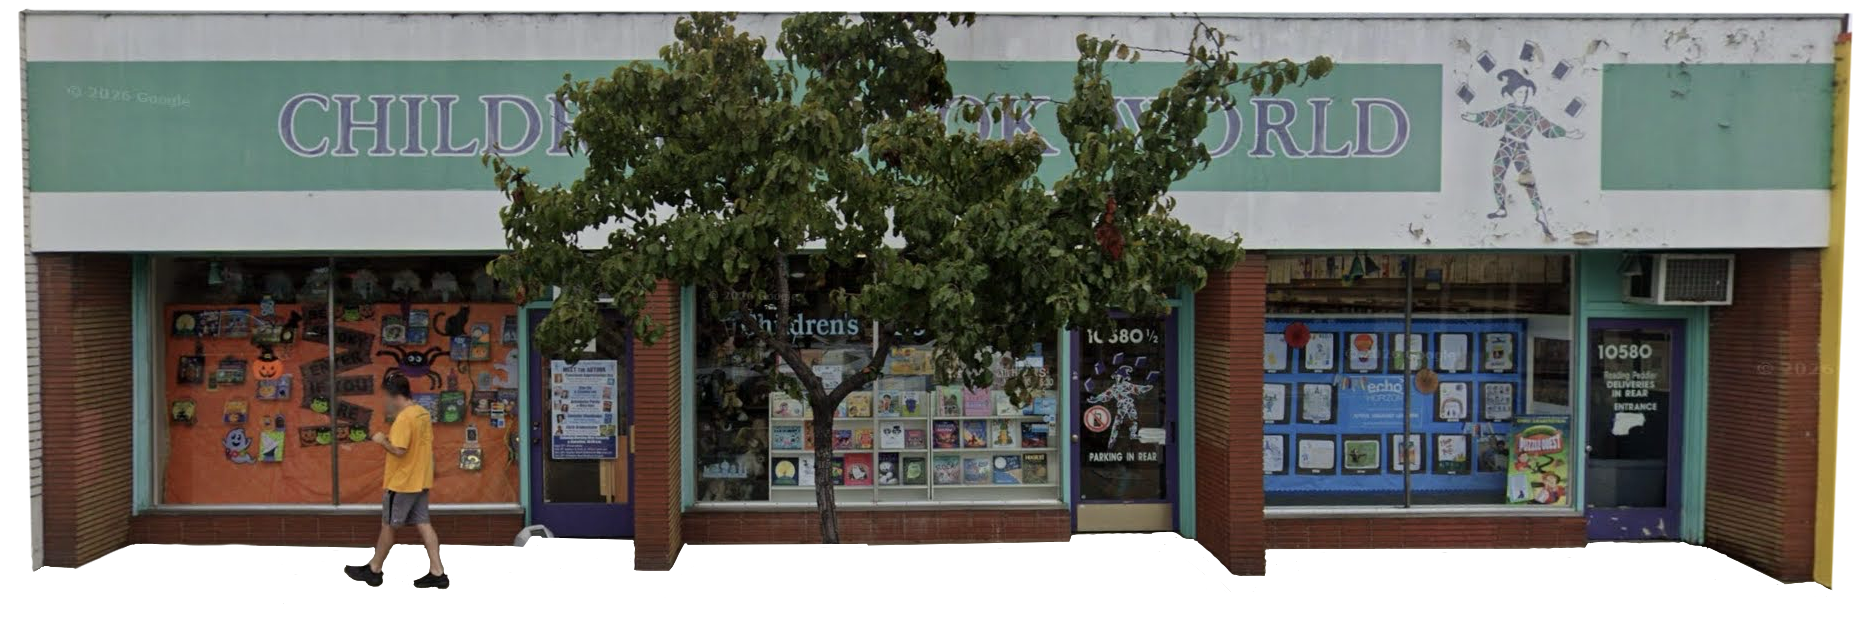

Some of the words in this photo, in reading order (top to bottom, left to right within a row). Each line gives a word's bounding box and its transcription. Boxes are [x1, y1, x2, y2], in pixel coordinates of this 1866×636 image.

[278, 93, 593, 158] CHILDR
[1598, 344, 1652, 359] 10580
[1367, 378, 1402, 393] echo
[1606, 381, 1655, 389] DELIVERIES
[1625, 389, 1648, 397] REAR
[1614, 403, 1657, 411] ENTRANCE
[1089, 452, 1123, 462] PARKING
[1126, 452, 1134, 461] IN
[1138, 452, 1157, 461] REAR
